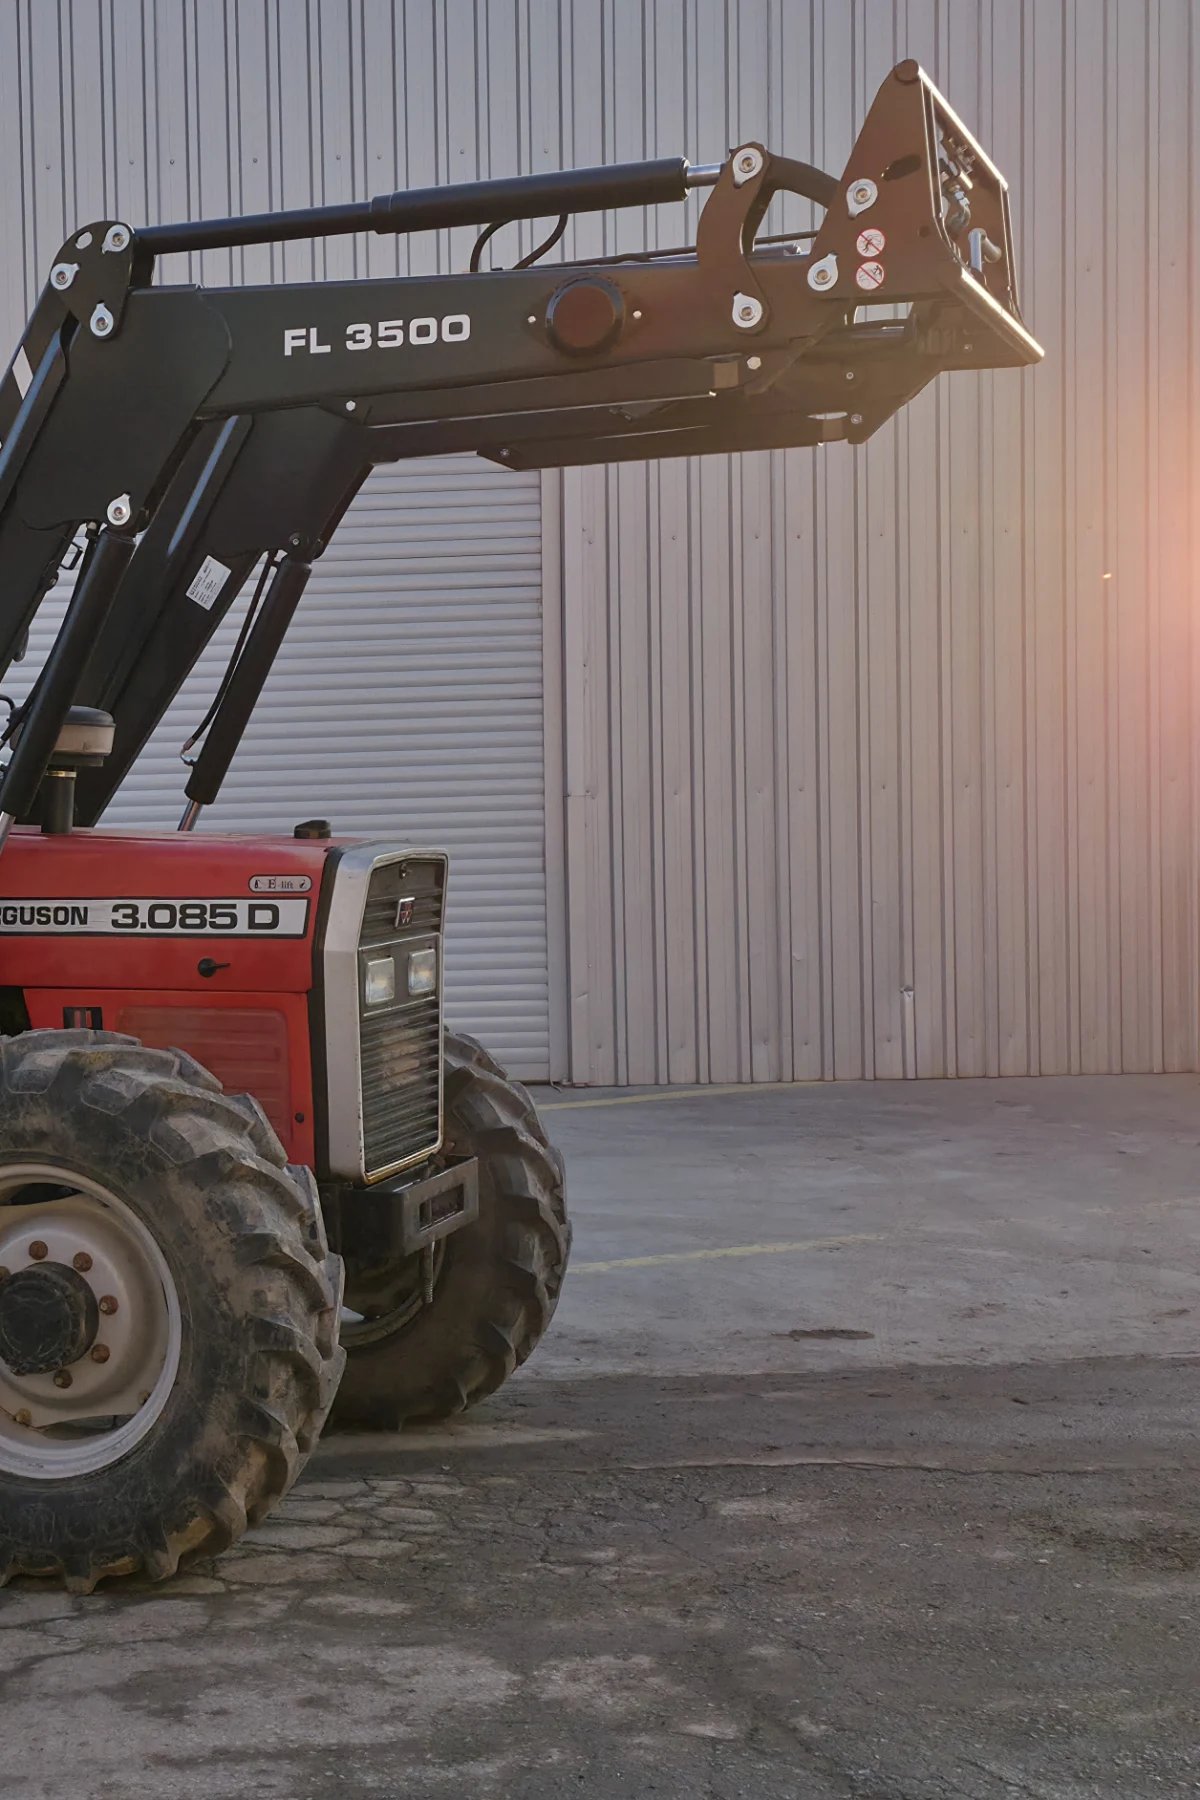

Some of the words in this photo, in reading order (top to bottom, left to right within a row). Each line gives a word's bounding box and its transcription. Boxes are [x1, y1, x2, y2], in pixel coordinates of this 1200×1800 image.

[284, 327, 332, 357] FL
[345, 313, 471, 351] 3500
[111, 903, 239, 930] 3.085
[247, 903, 280, 930] D
